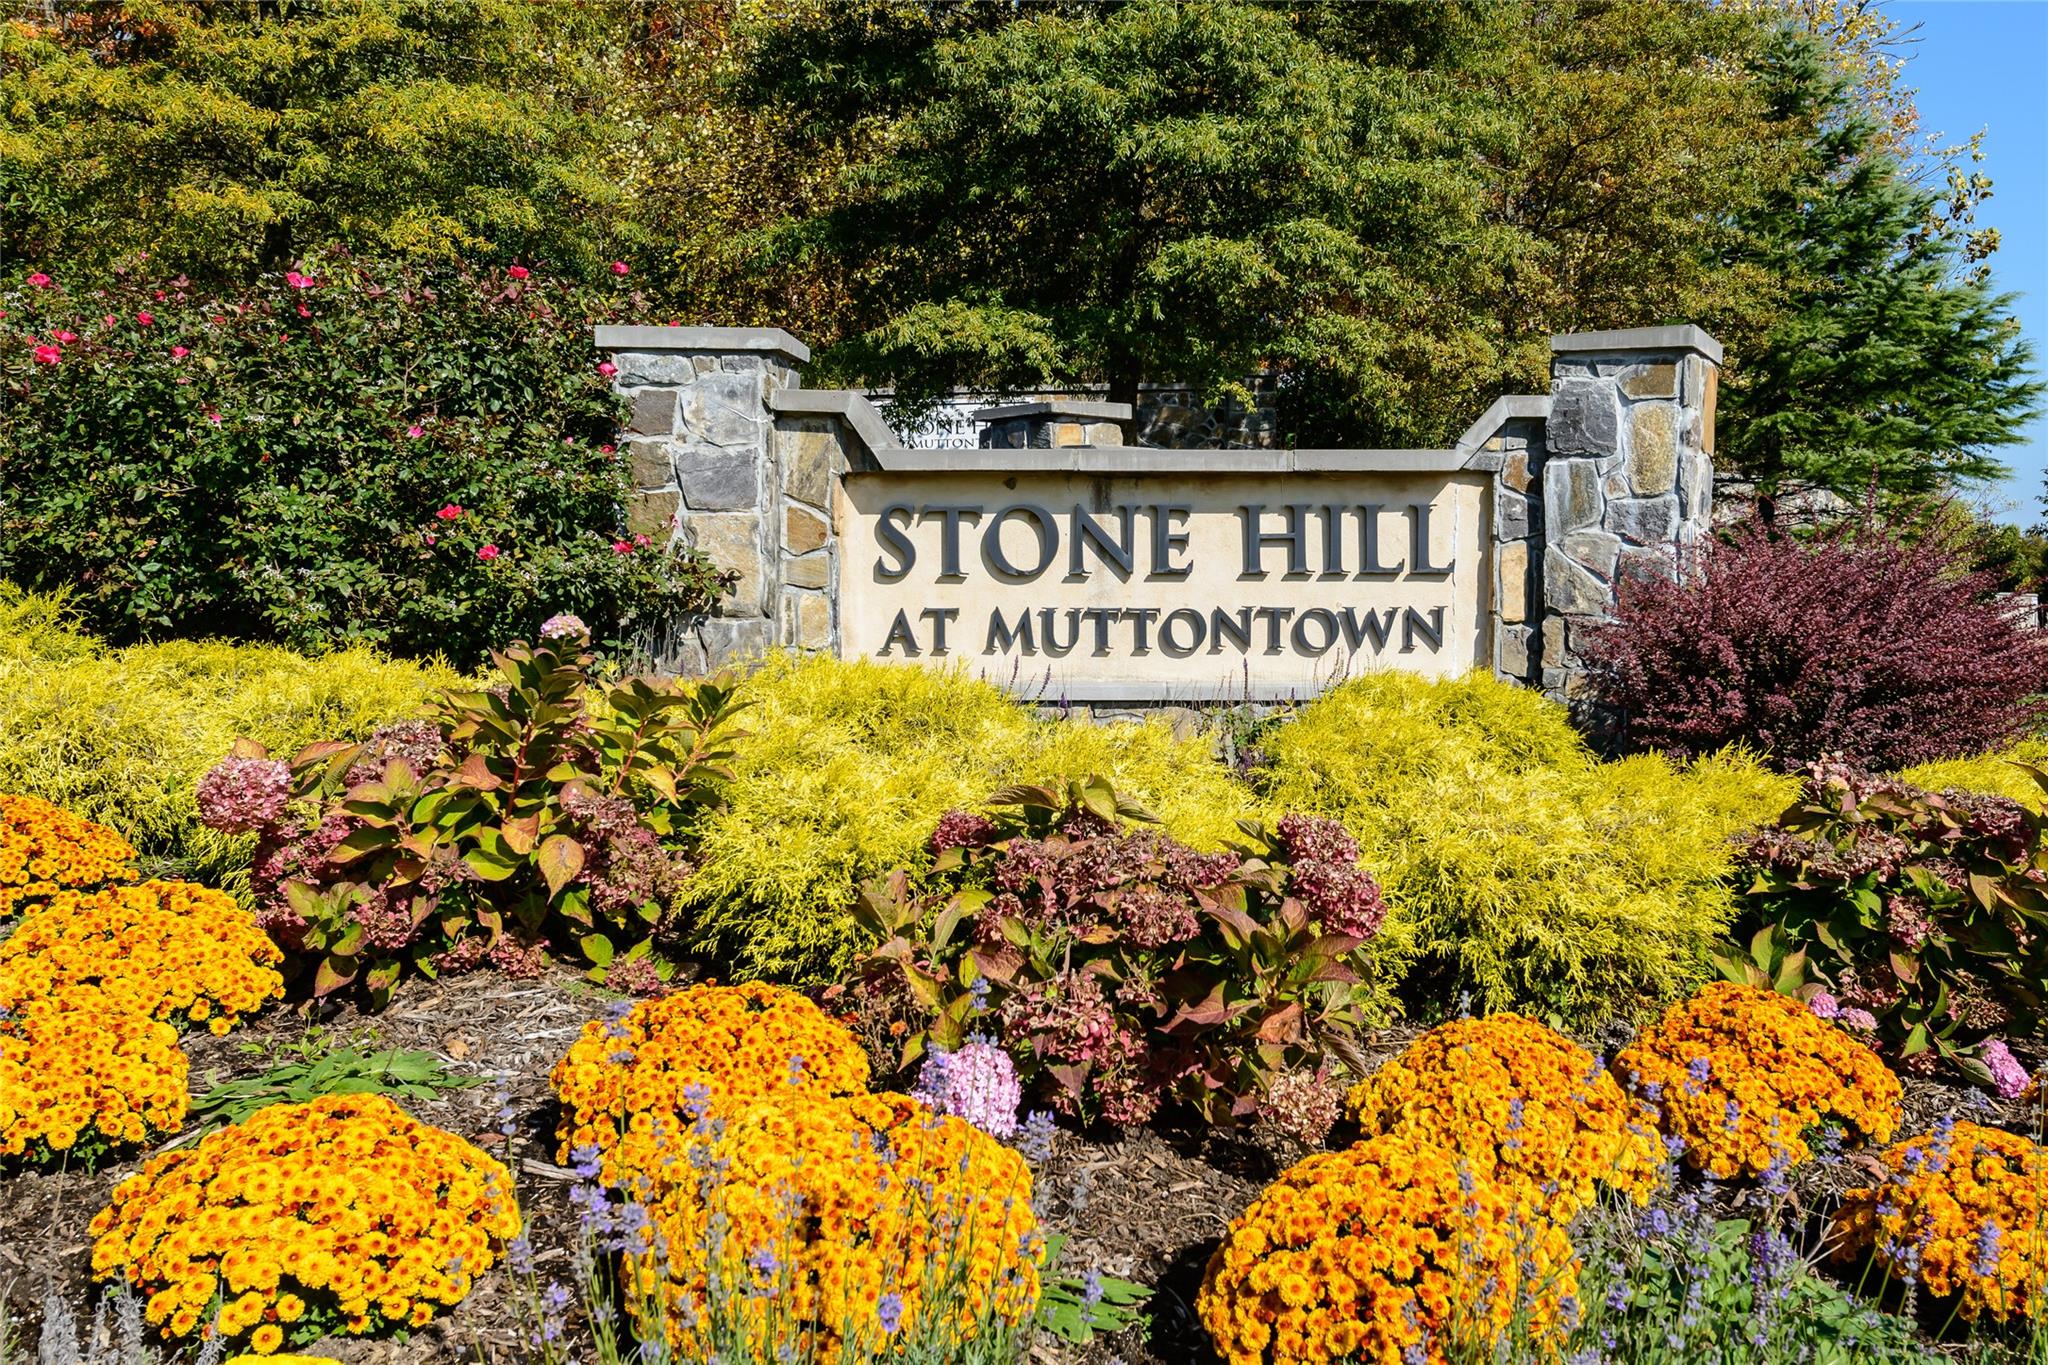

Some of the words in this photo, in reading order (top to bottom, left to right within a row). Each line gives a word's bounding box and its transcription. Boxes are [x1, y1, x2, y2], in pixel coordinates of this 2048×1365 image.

[911, 438, 980, 449] MUTTON
[876, 503, 1193, 577] STONE
[1237, 503, 1455, 575] HILL
[878, 607, 960, 651] AT
[986, 605, 1448, 652] MUTTONTOWN
